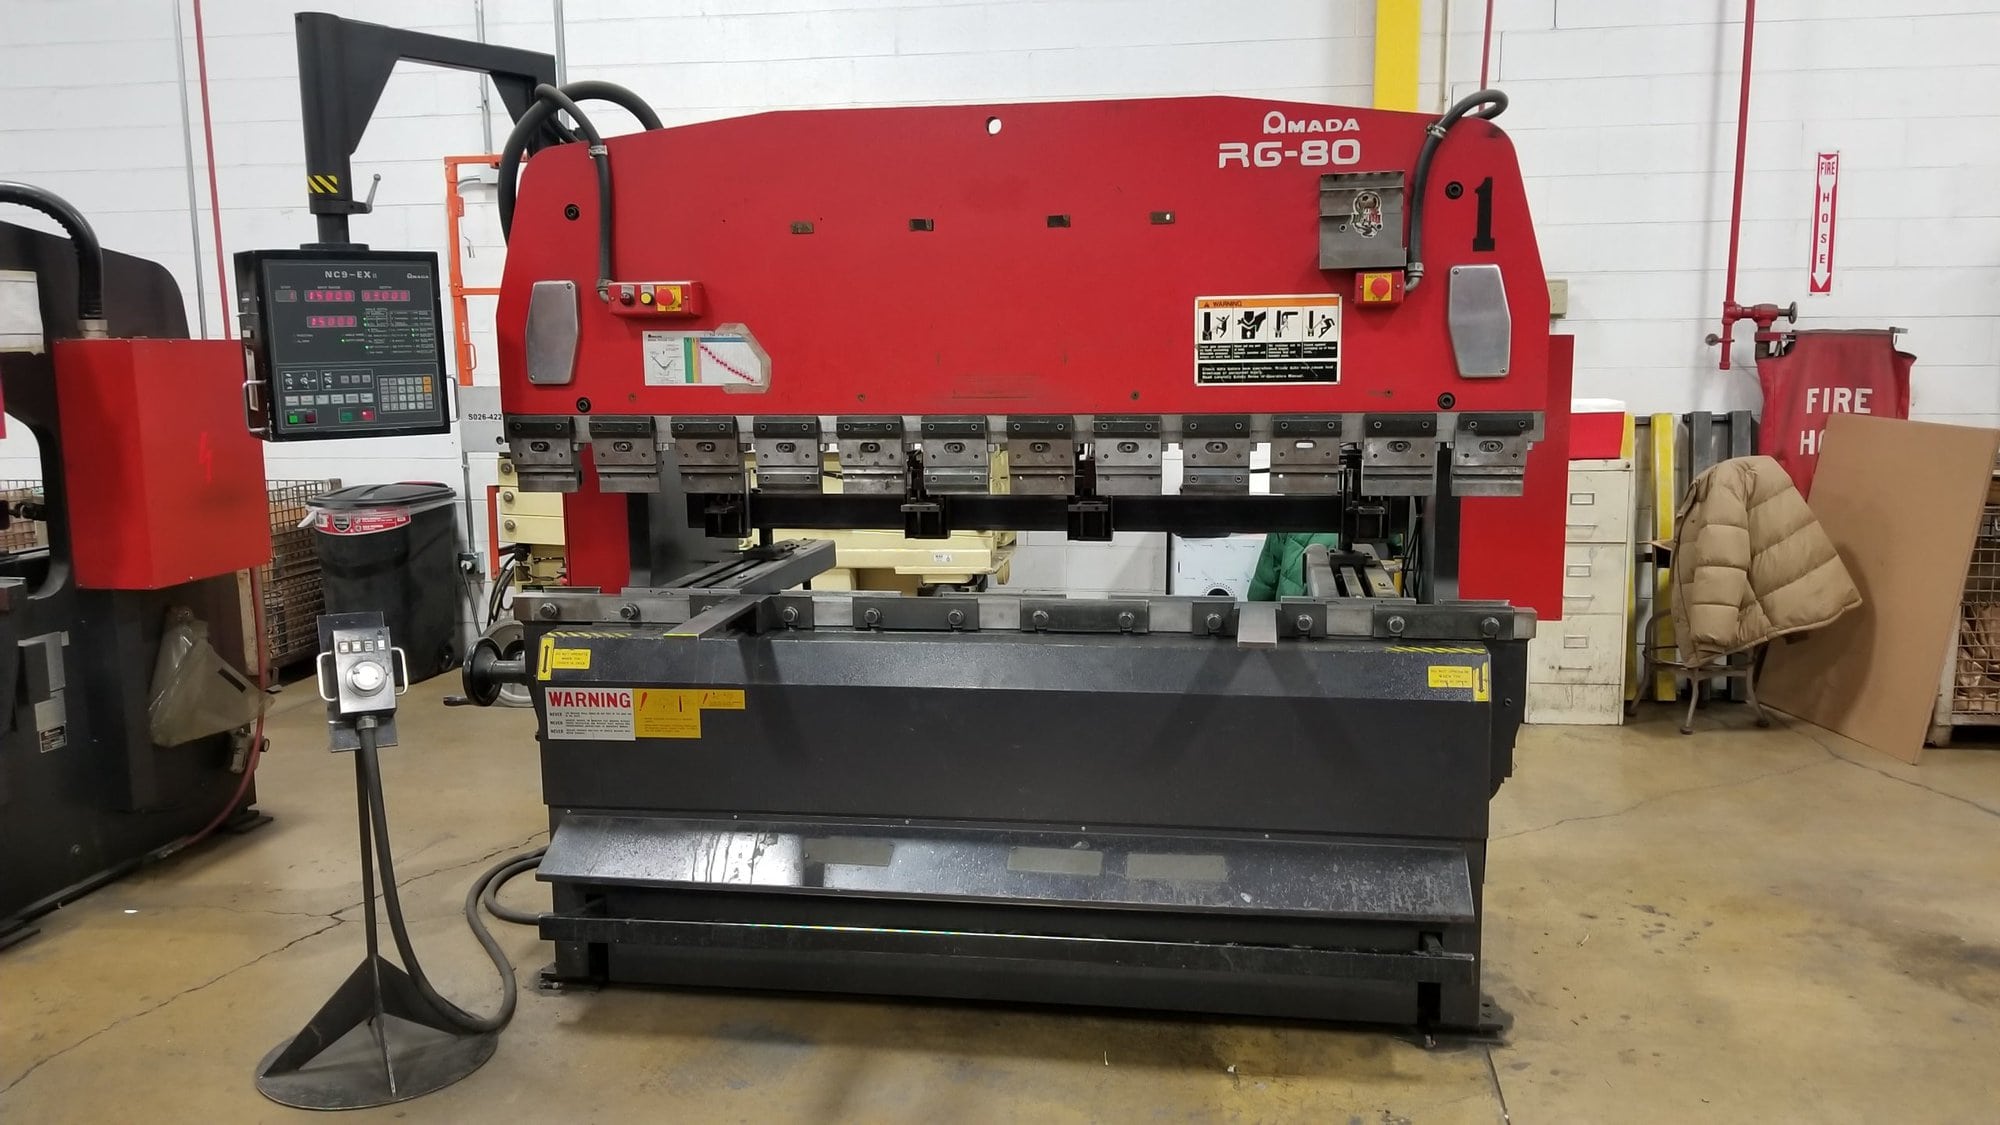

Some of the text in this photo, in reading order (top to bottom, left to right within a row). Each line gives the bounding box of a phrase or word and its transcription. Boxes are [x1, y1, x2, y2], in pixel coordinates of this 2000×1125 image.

[1218, 138, 1361, 169] RG-80
[1820, 161, 1836, 175] FIRE
[1472, 176, 1495, 252] 1
[1819, 192, 1830, 264] HOSE
[1806, 387, 1873, 414] FIRE
[548, 691, 632, 709] WARNING
